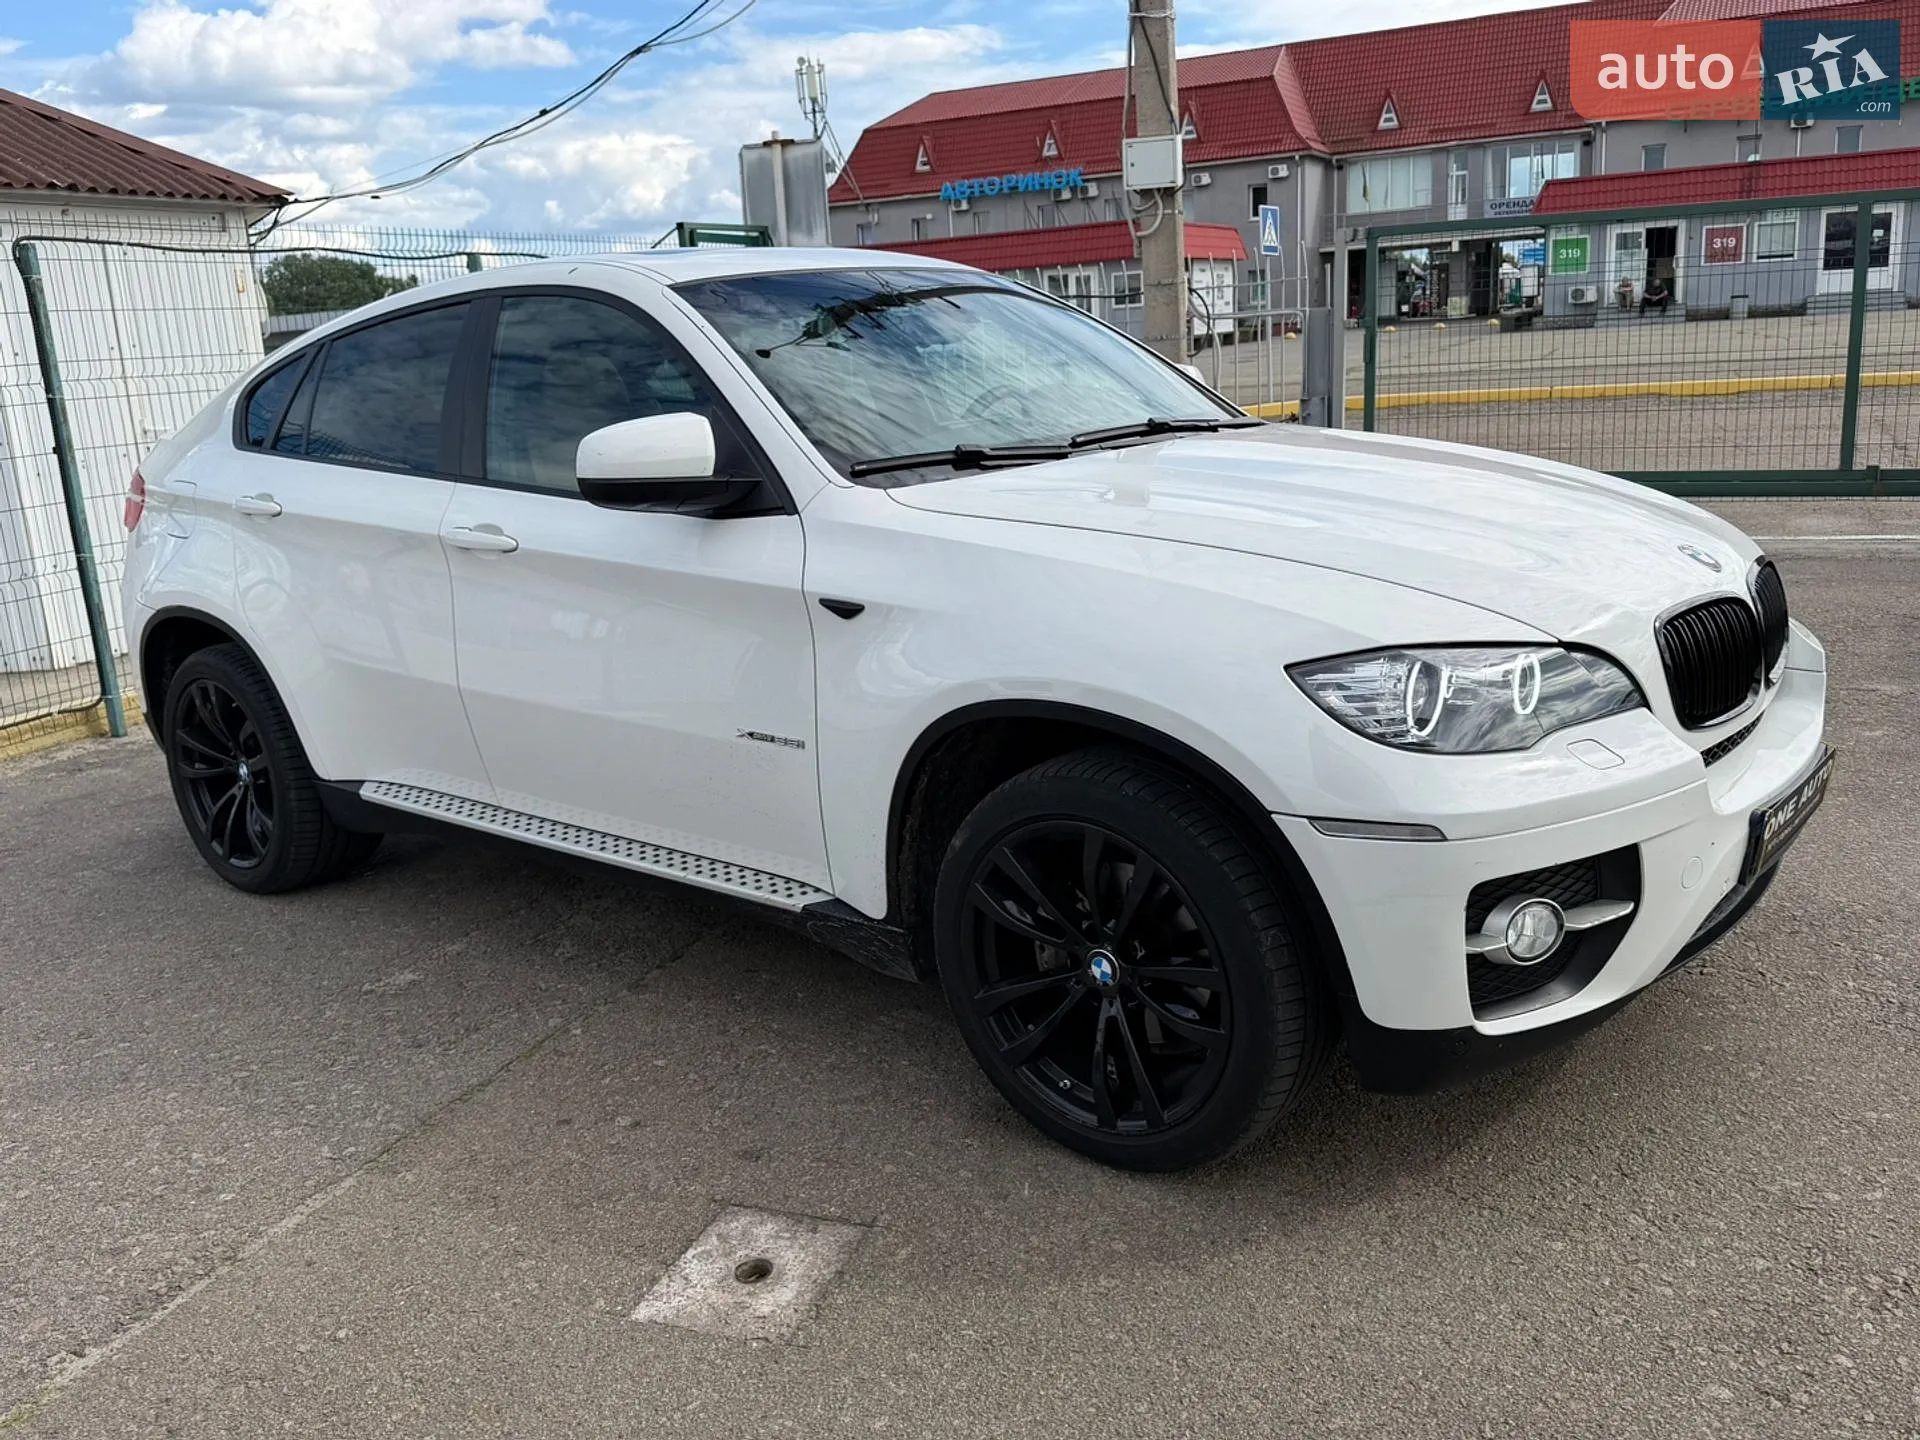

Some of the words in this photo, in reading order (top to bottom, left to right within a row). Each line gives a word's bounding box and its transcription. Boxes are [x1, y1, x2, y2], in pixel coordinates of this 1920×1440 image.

[939, 167, 1084, 200] АВТОРИНОК
[1559, 248, 1580, 259] 319
[1711, 237, 1736, 248] 319
[1764, 797, 1798, 841] ONE
[1798, 758, 1834, 808] AUTO
